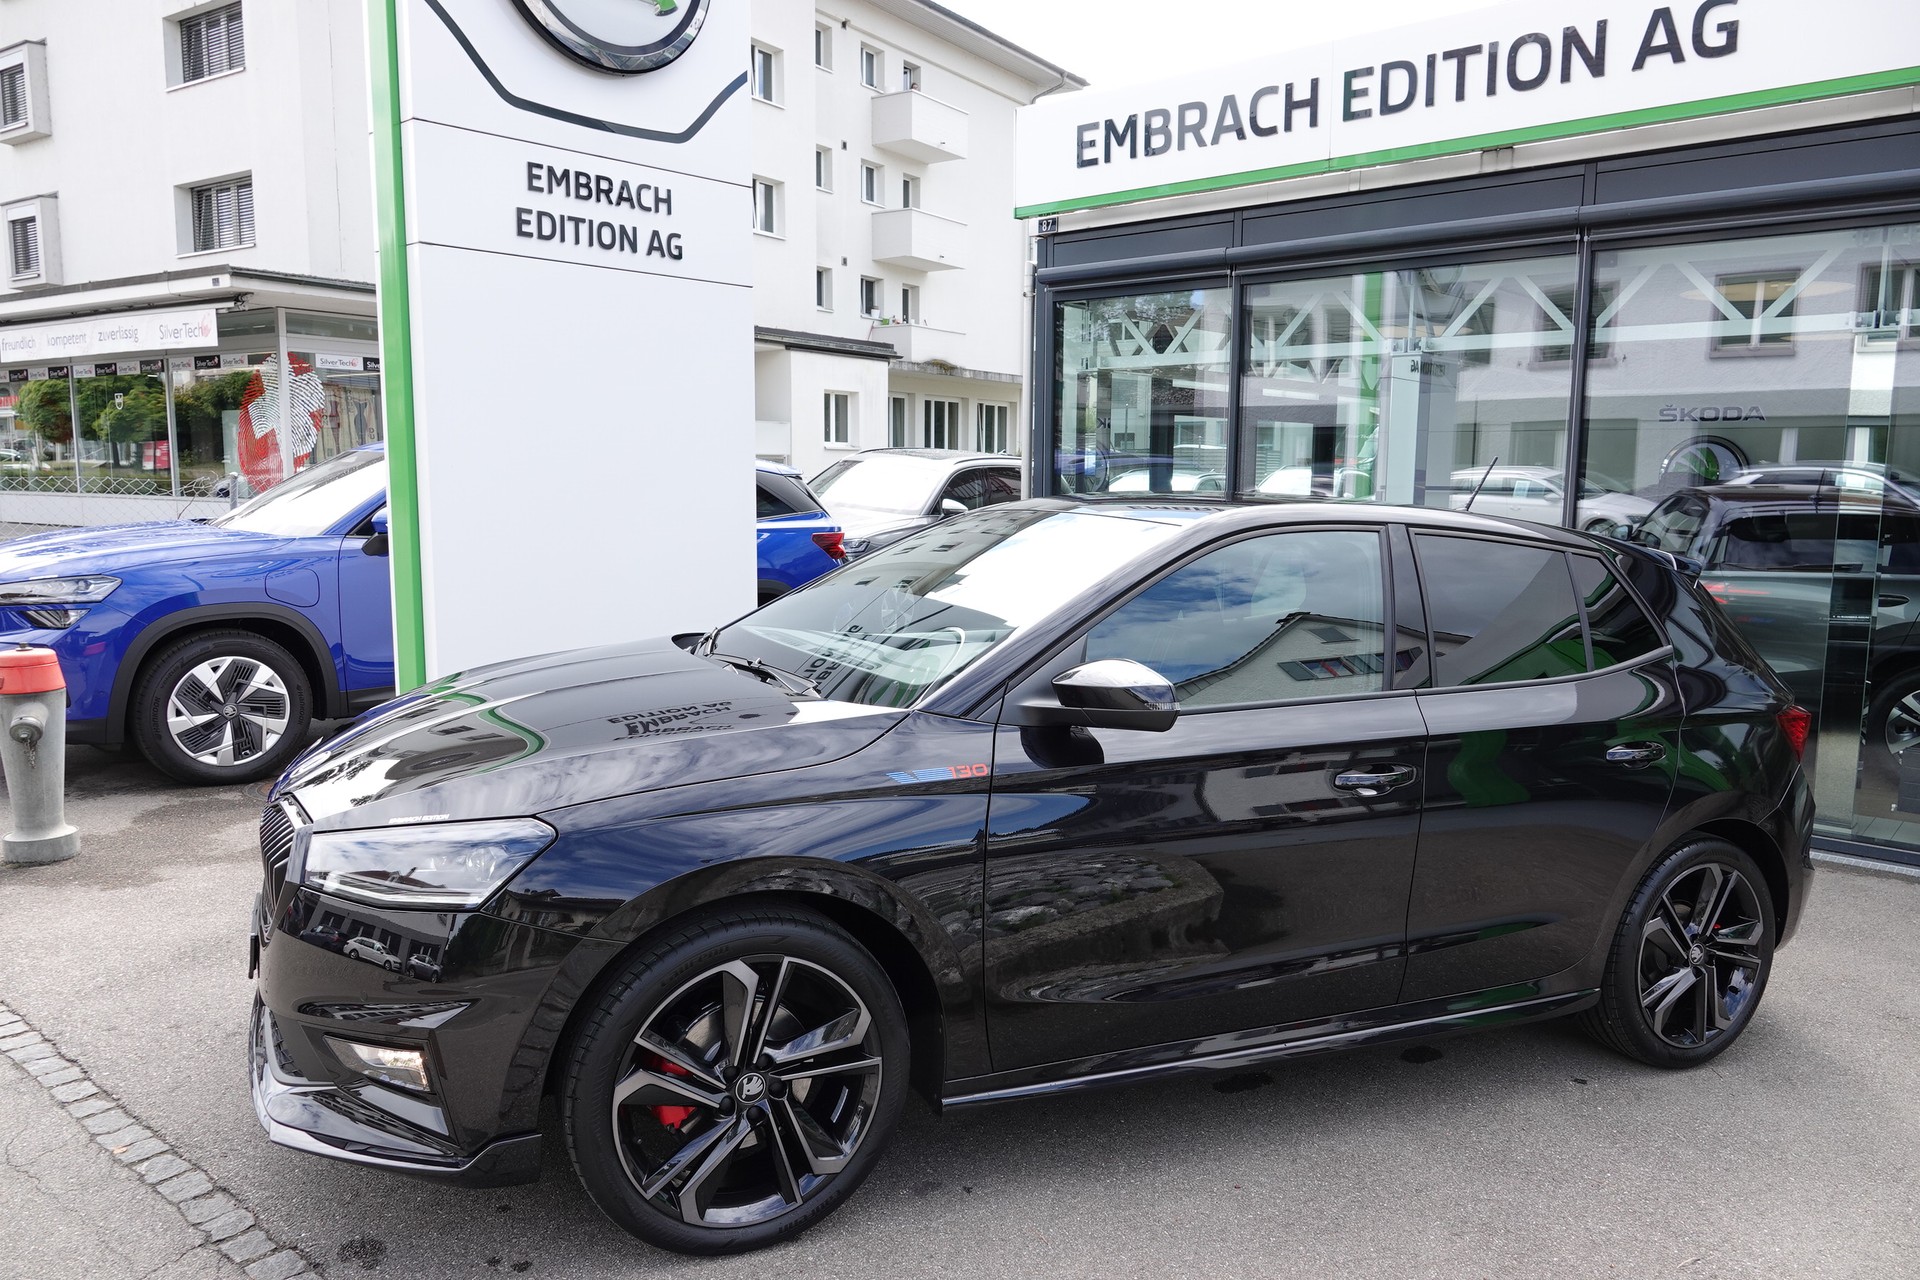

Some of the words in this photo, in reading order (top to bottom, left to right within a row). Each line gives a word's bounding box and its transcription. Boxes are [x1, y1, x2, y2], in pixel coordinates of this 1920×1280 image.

[1077, 77, 1319, 169] EMBRACH
[1343, 18, 1608, 122] EDITION
[1632, 0, 1739, 72] AG
[527, 161, 672, 215] EMBRACH
[516, 207, 638, 253] EDITION
[646, 229, 683, 260] AG
[1042, 219, 1053, 232] 87
[1, 337, 37, 351] freundlich
[47, 332, 87, 349] kompetent
[1658, 404, 1765, 422] ŠKODA
[946, 763, 988, 779] 130
